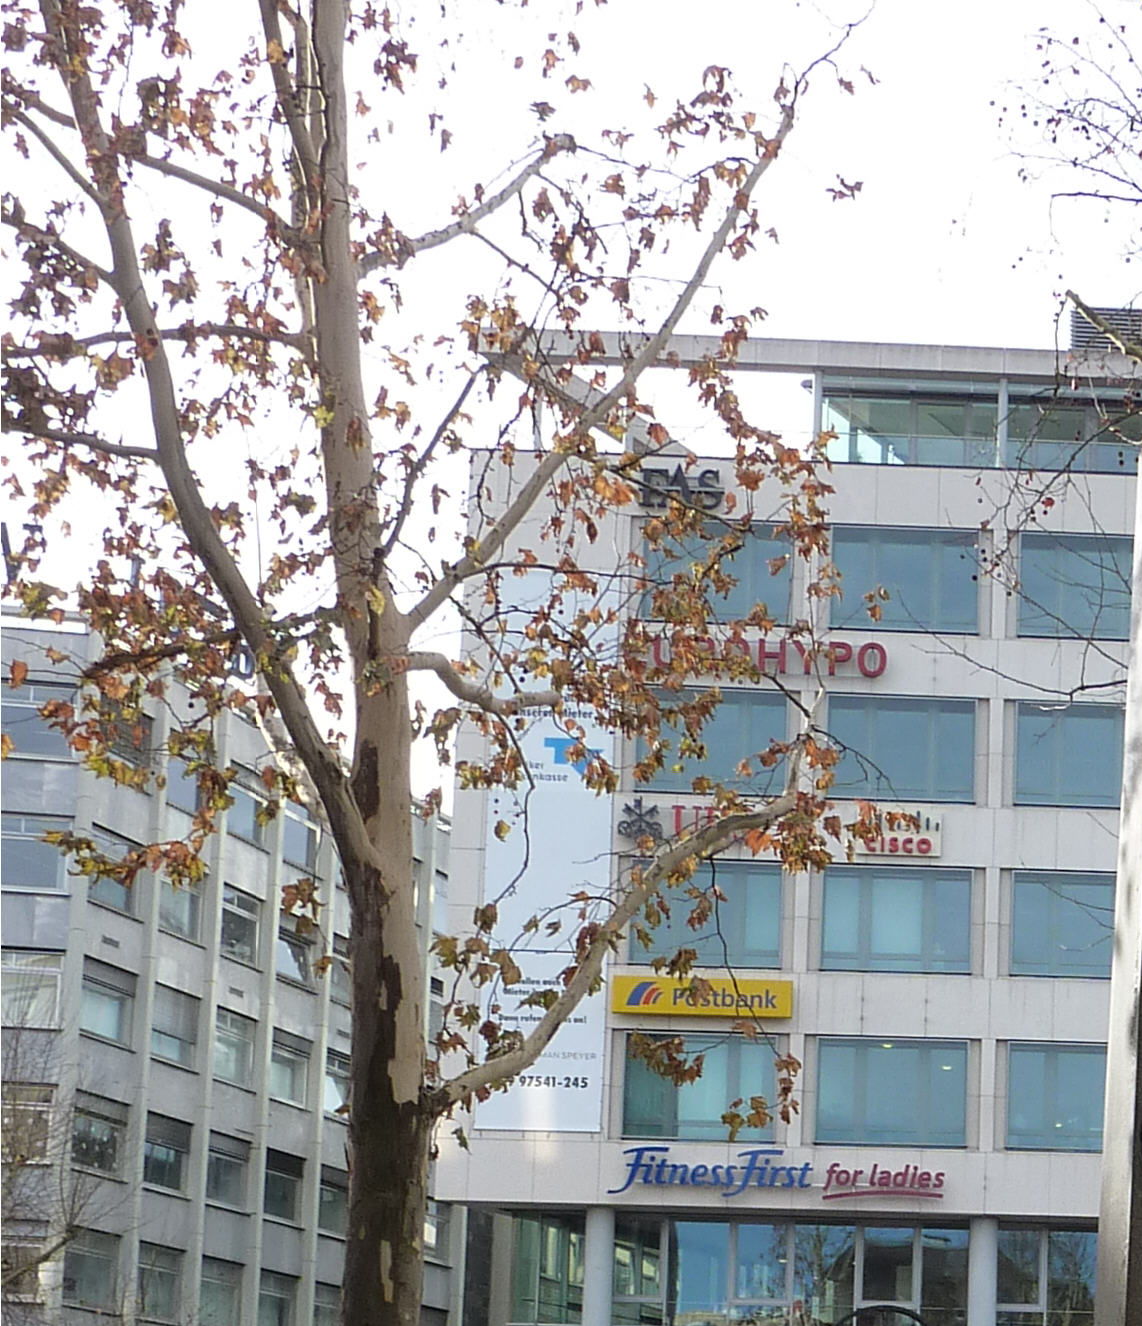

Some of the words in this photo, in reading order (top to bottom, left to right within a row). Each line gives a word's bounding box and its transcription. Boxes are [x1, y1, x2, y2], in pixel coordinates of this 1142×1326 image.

[672, 987, 777, 1009] Postbank
[519, 1076, 588, 1088] 97541-245
[823, 1163, 863, 1190] for
[870, 1163, 945, 1189] ladies
